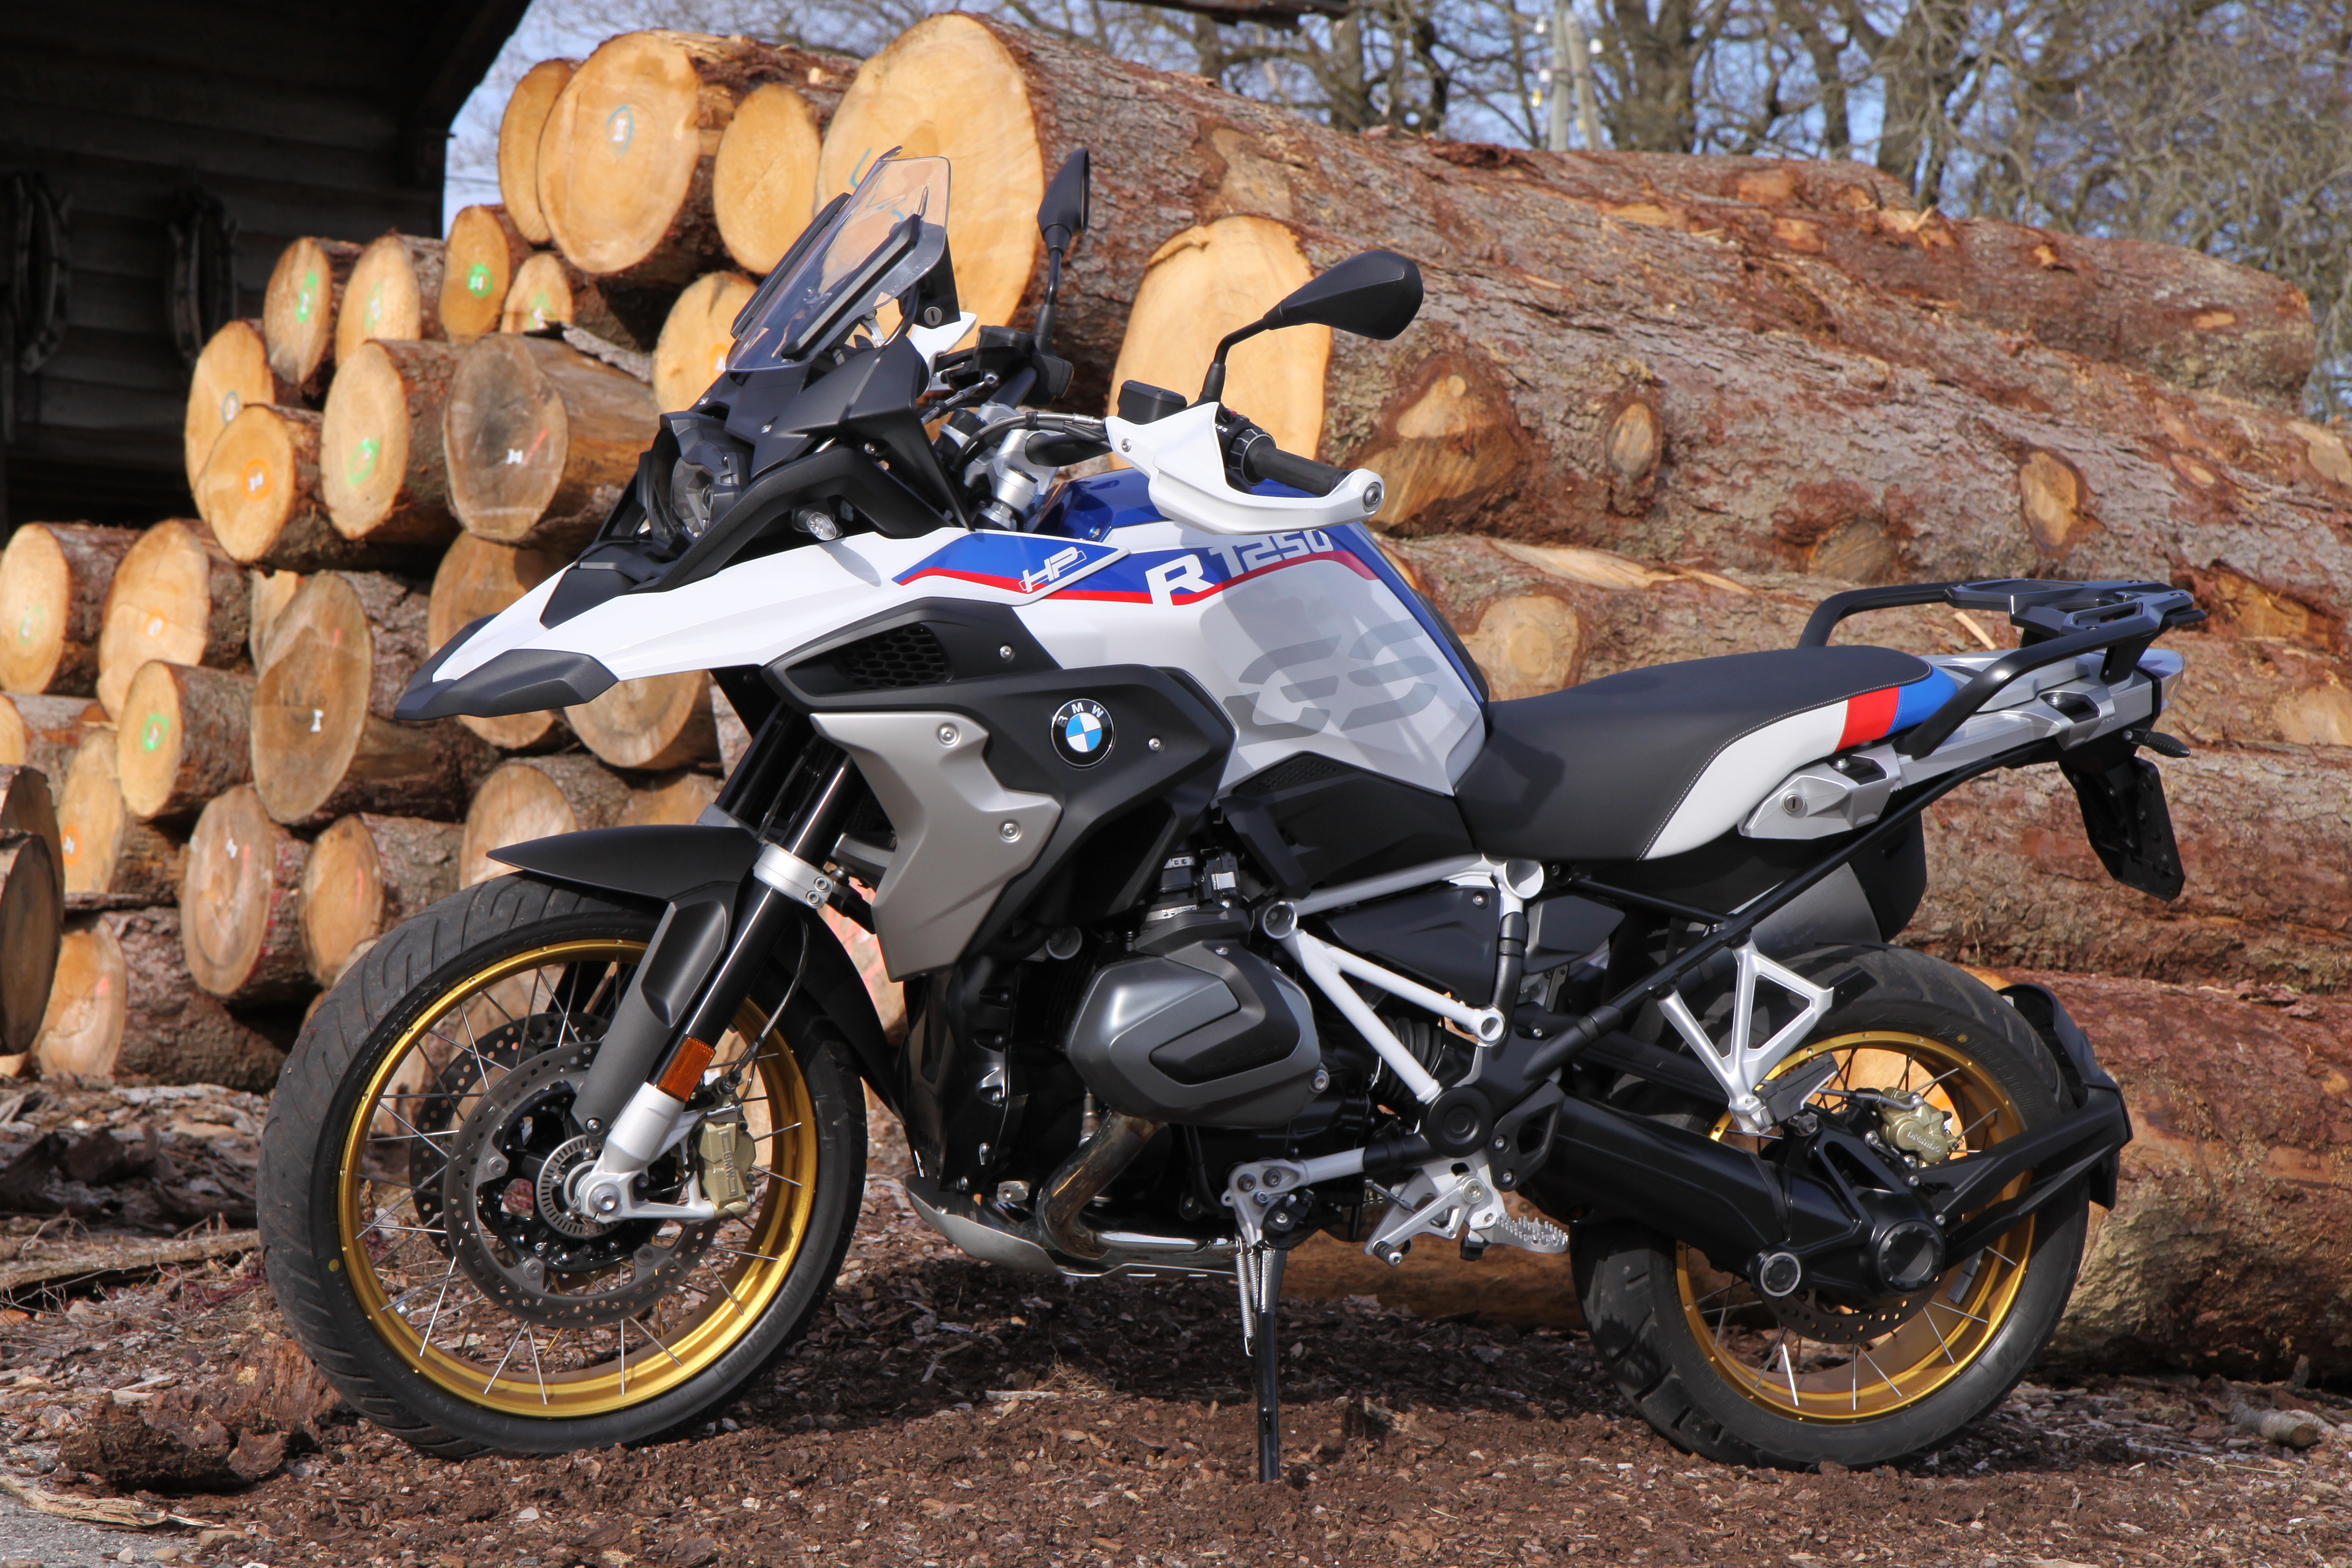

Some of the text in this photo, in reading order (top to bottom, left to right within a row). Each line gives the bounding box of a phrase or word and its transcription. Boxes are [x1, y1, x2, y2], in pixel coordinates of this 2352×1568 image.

[1020, 546, 1083, 593] HP
[1145, 529, 1334, 606] R 1250
[1223, 618, 1438, 748] GS
[1056, 702, 1104, 728] BMW
[1907, 1128, 1942, 1154] brembo
[723, 1151, 735, 1180] BMW
